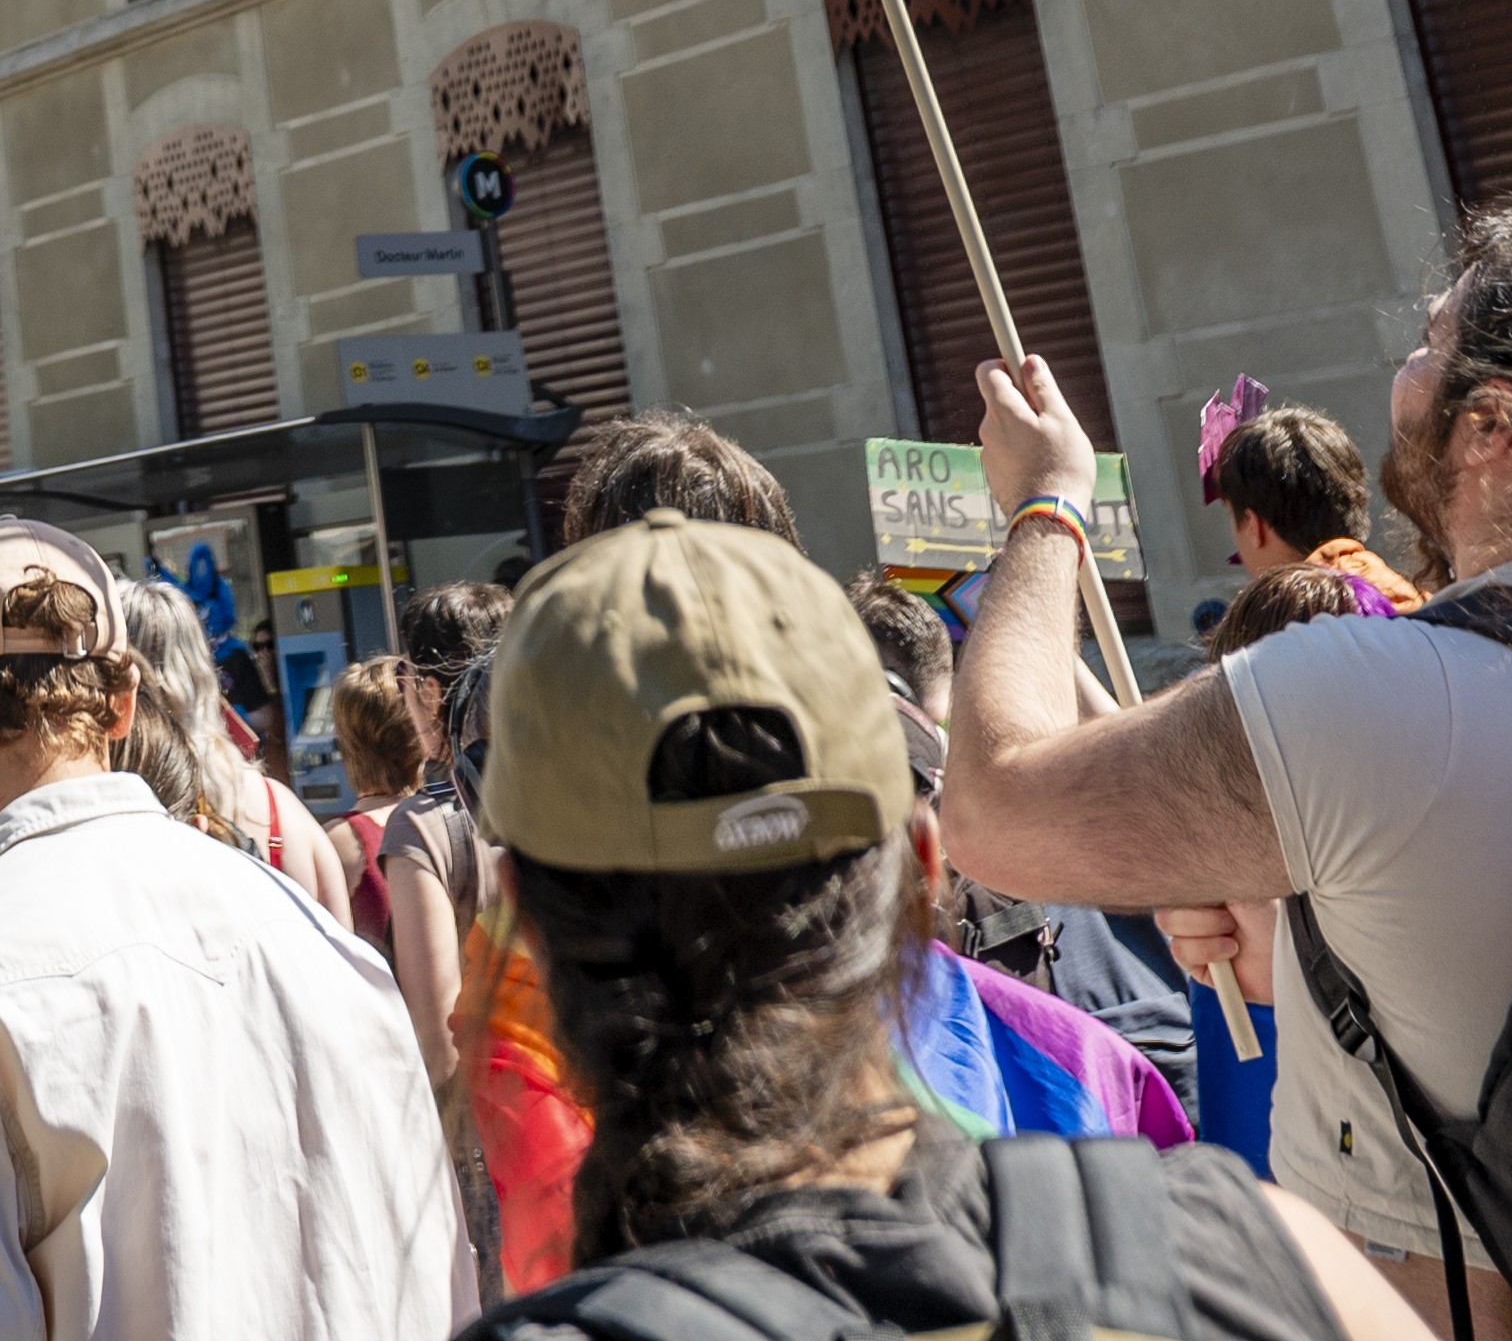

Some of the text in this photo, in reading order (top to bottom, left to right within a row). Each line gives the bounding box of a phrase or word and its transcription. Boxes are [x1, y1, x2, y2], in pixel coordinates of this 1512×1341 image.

[474, 170, 502, 200] M
[878, 446, 951, 484] ARO
[880, 487, 968, 529] SANS
